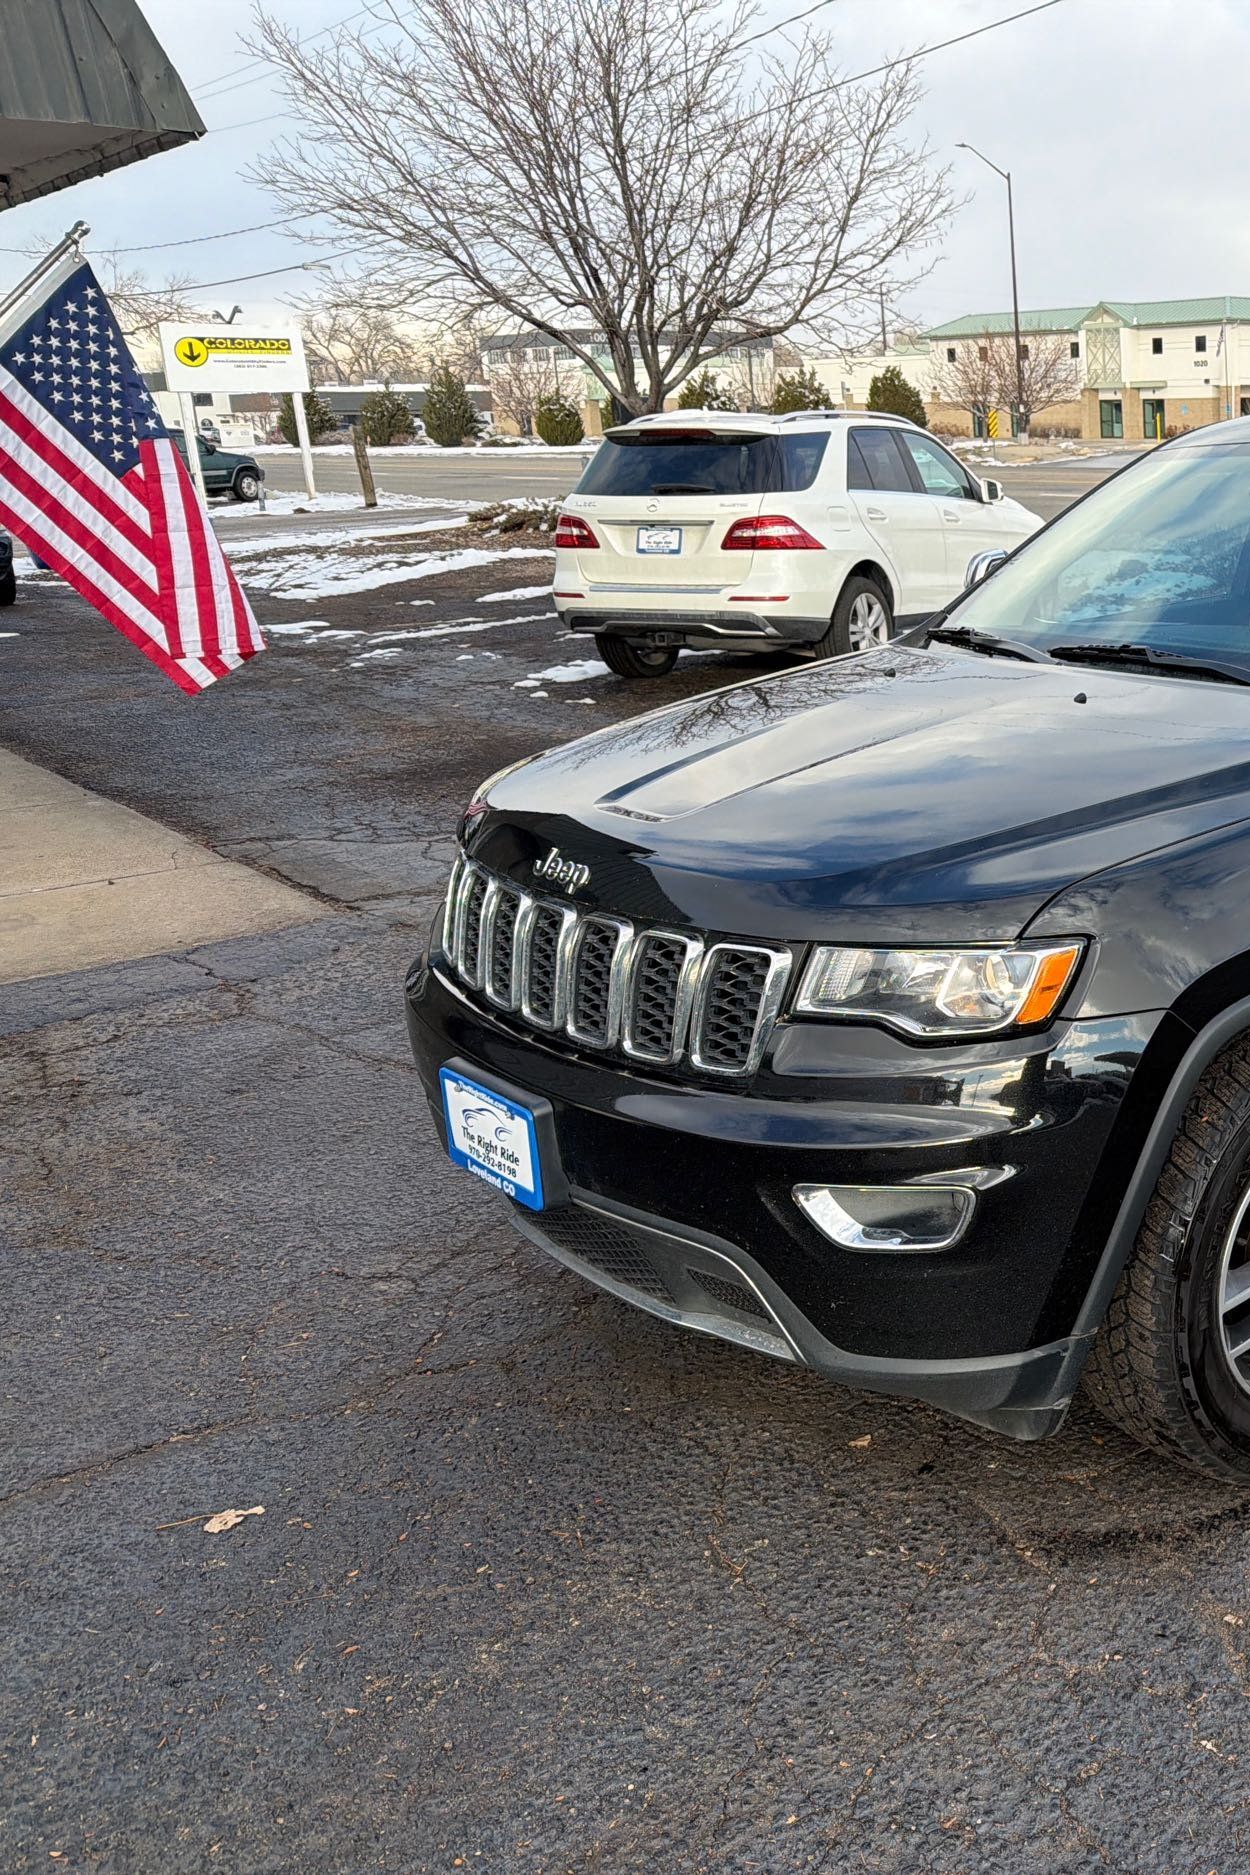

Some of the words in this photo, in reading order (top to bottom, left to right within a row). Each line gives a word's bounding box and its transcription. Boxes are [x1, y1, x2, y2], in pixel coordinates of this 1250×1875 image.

[203, 337, 289, 349] COLORADO
[532, 847, 590, 894] Jeep
[461, 1124, 476, 1144] The
[477, 1134, 499, 1157] Right
[500, 1146, 520, 1167] Ride
[467, 1158, 502, 1189] Loveland
[503, 1180, 516, 1197] CO
